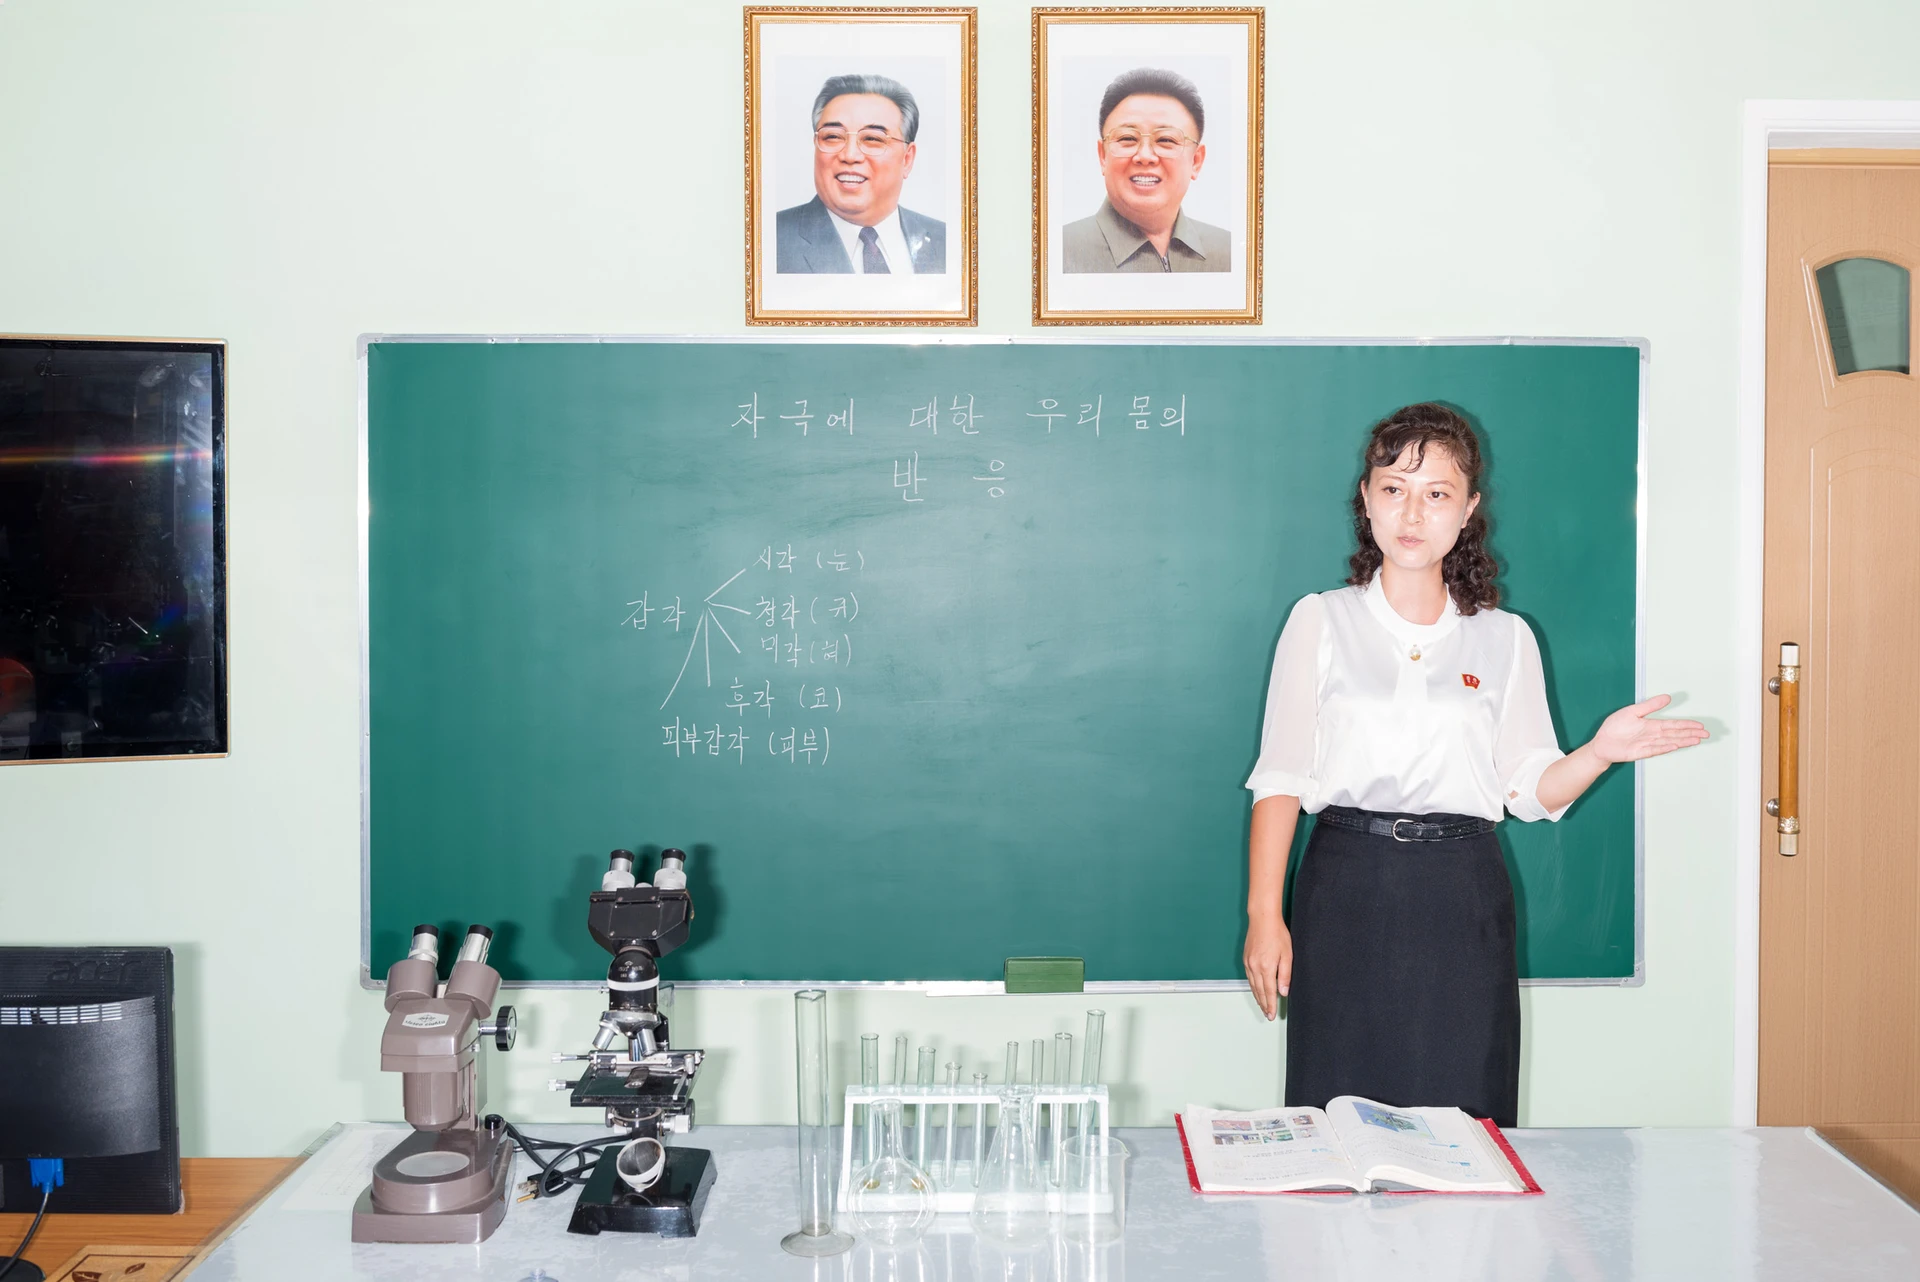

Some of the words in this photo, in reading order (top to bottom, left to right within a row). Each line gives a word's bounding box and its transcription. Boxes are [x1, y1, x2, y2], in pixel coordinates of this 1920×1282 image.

[731, 392, 854, 438] 자극에
[909, 394, 984, 435] 대한
[752, 543, 797, 573] 시각
[755, 595, 800, 629] 청각
[761, 632, 802, 667] 미각
[725, 677, 775, 719] 후각
[46, 960, 143, 985] acer
